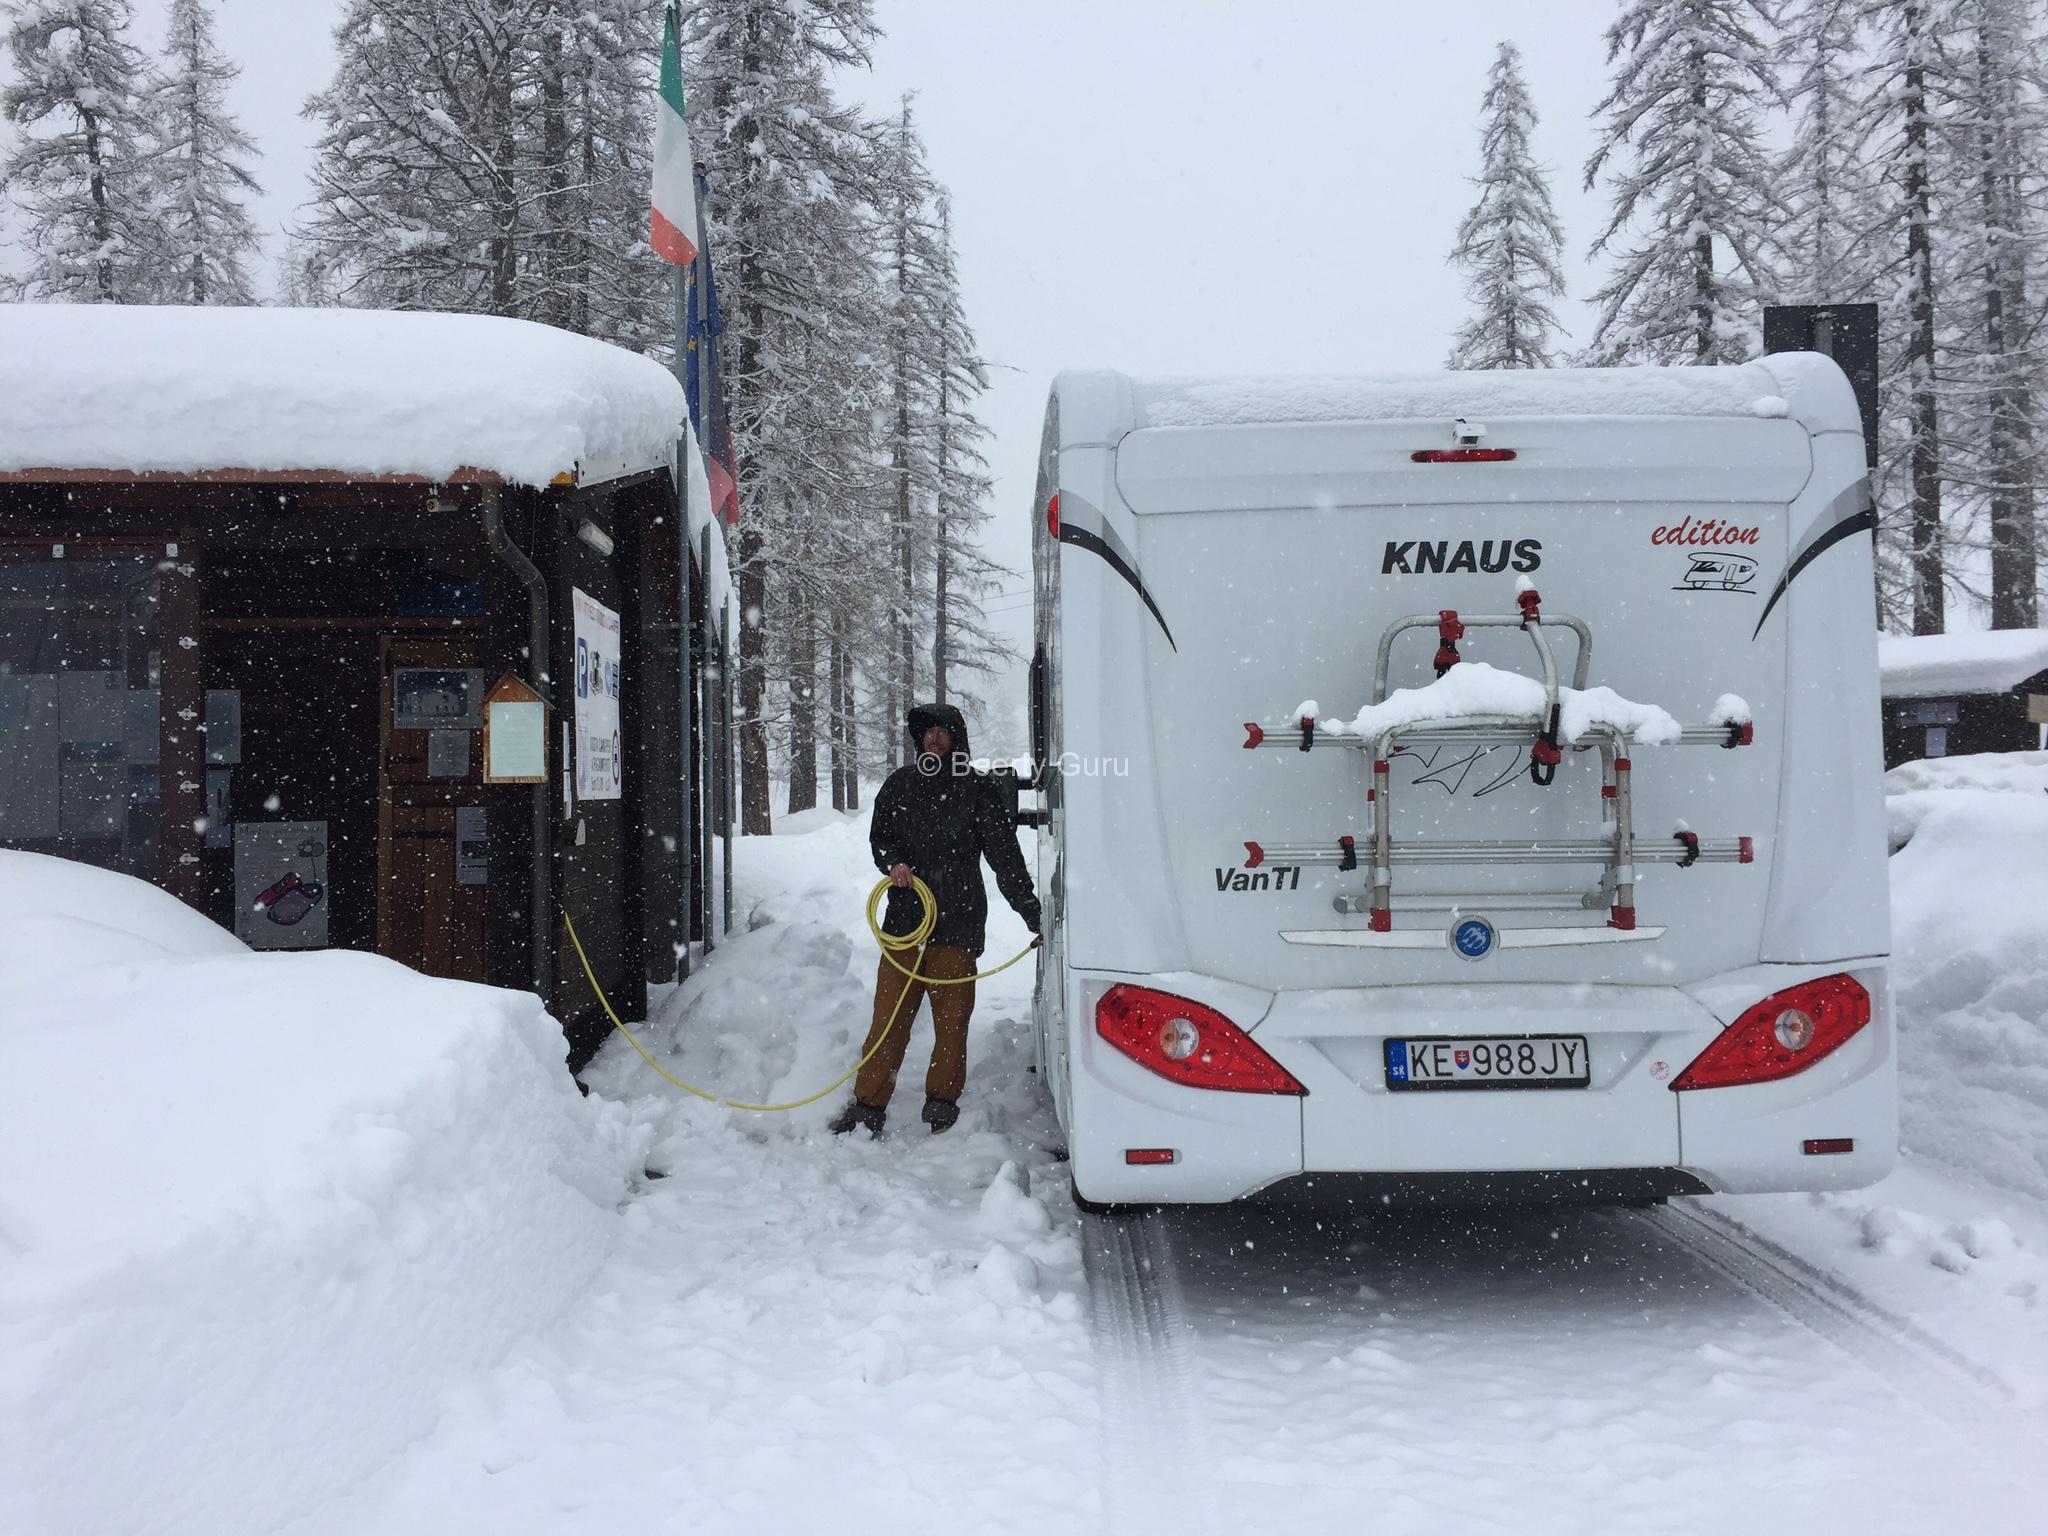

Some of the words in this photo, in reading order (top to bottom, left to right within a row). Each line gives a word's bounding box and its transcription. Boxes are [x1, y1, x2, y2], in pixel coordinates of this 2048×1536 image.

[1651, 515, 1760, 546] edition
[1381, 538, 1543, 574] KNAUS
[1392, 1065, 1405, 1076] SK
[1410, 1043, 1453, 1077] KE
[1472, 1041, 1578, 1076] 988JY
